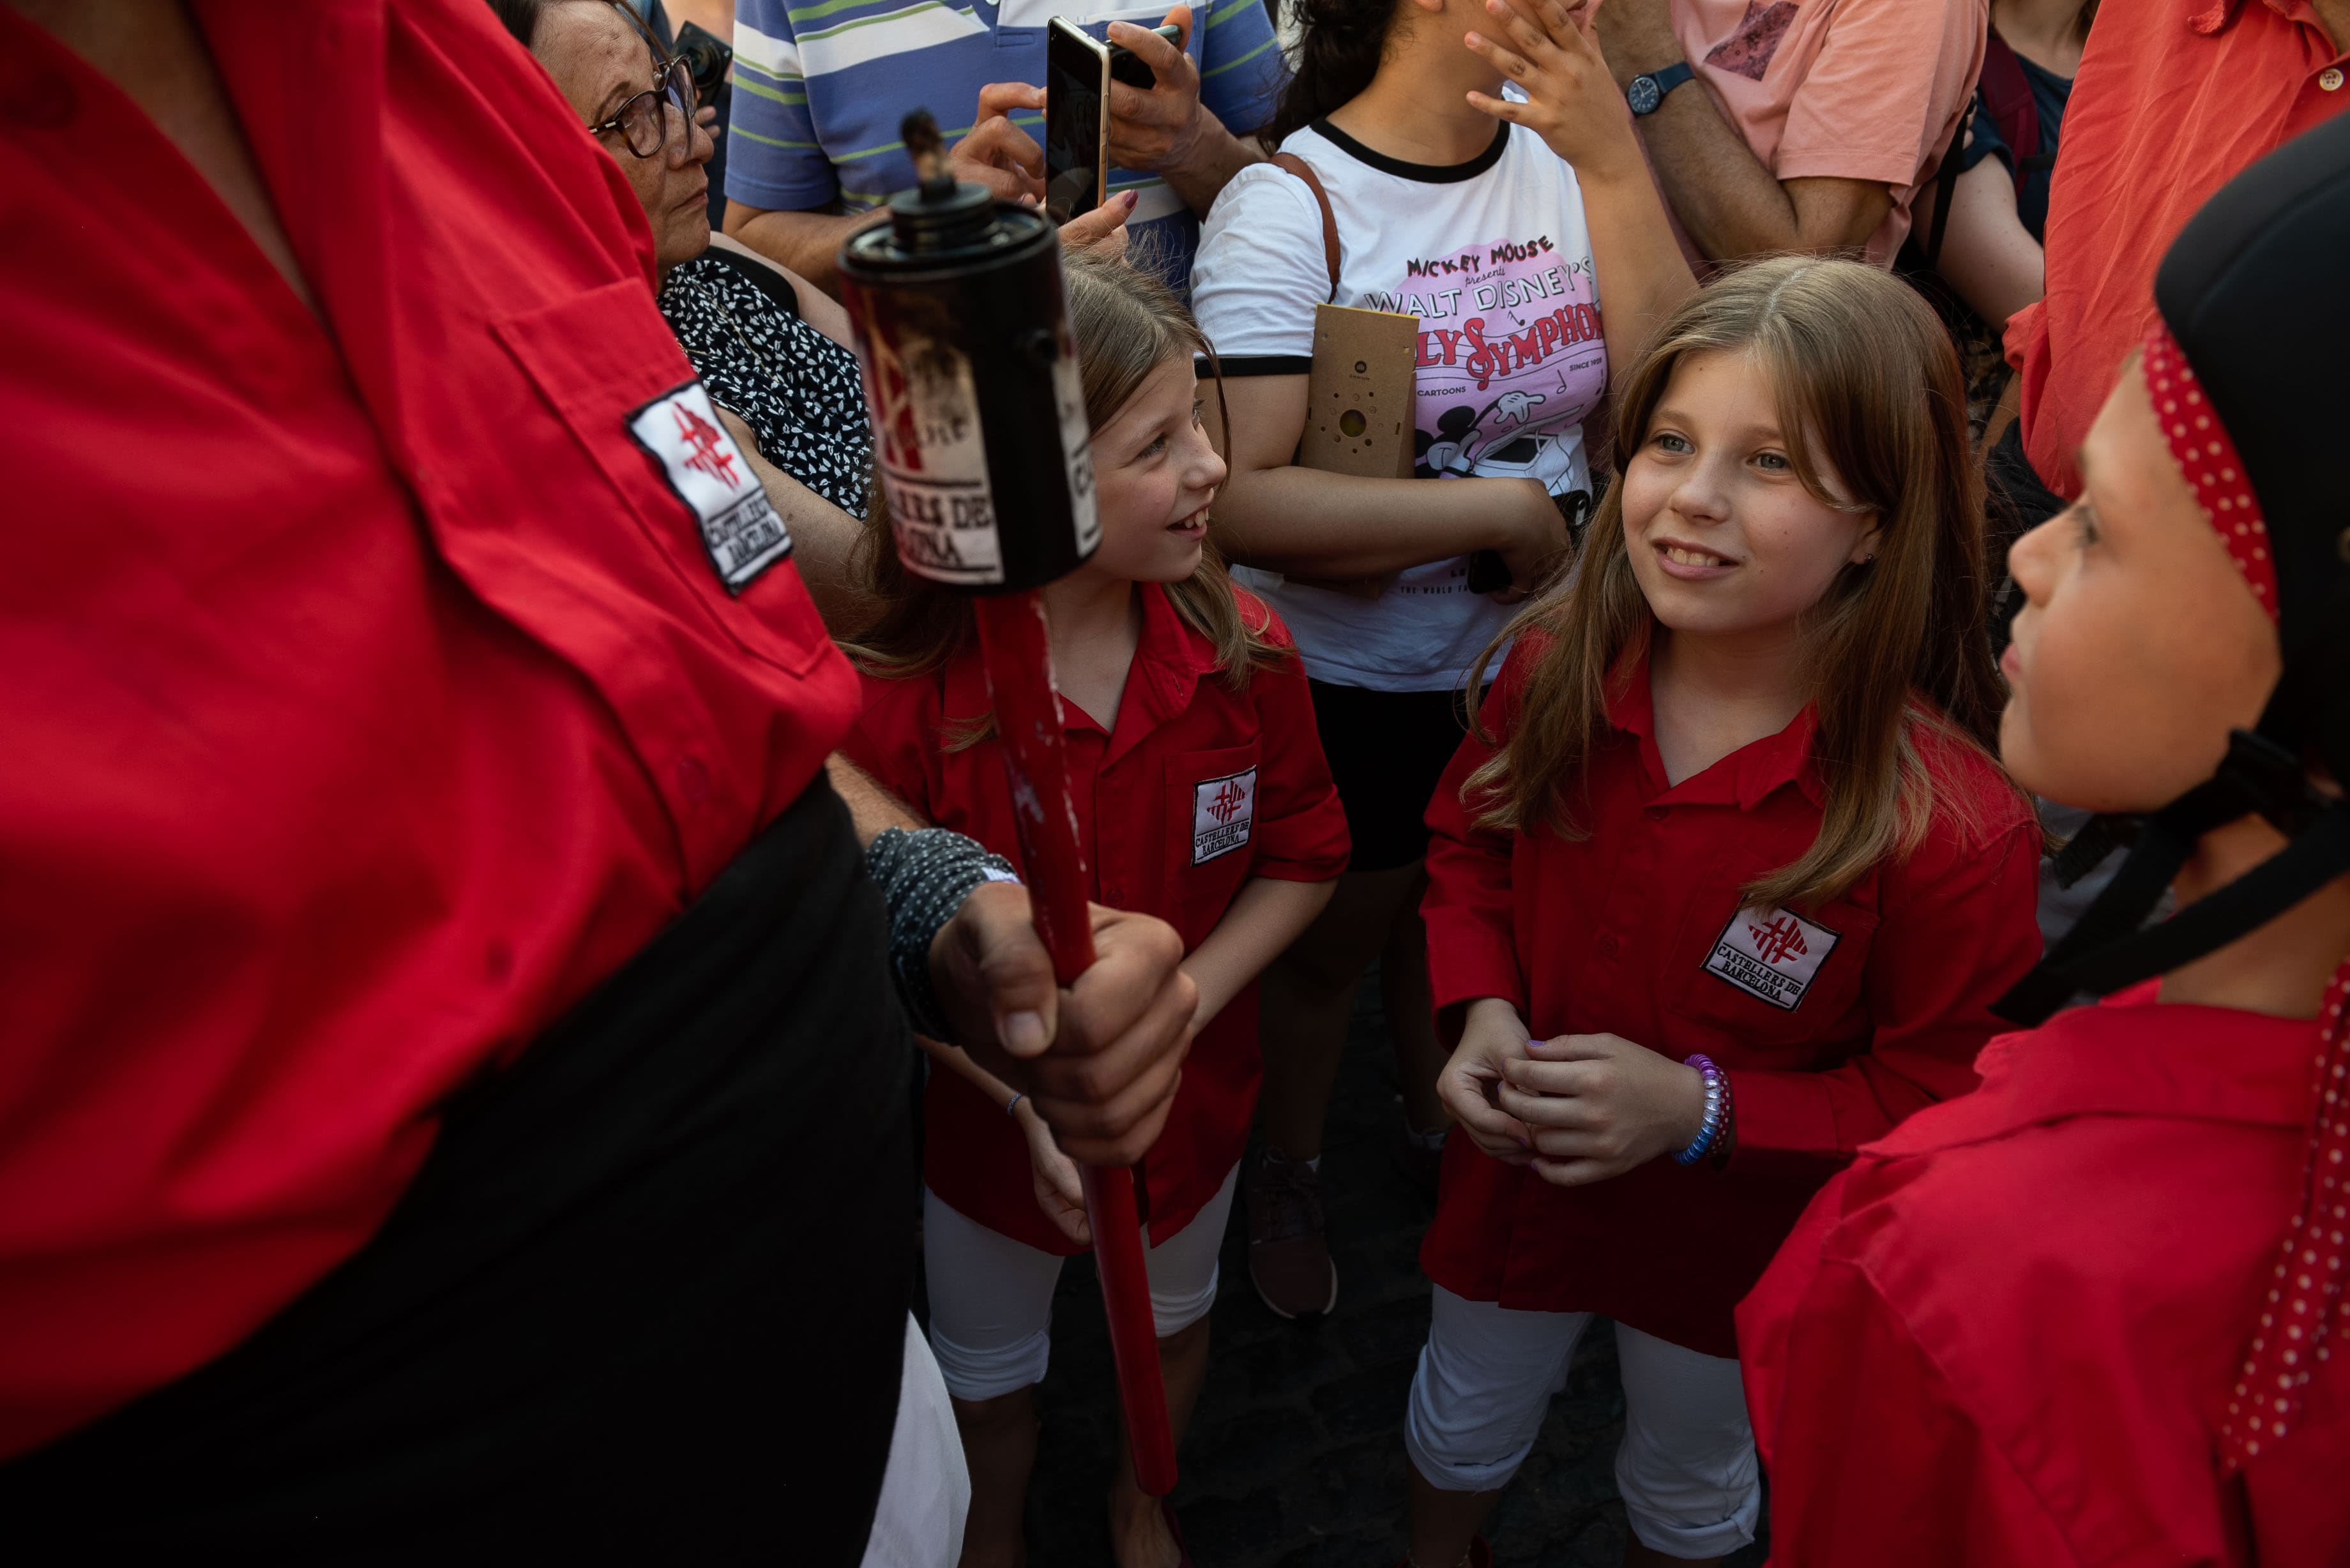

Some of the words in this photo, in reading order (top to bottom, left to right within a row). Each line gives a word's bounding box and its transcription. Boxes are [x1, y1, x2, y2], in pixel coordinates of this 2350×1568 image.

[1407, 253, 1481, 278] MICKEY
[1490, 235, 1554, 266] MOUSE
[1465, 266, 1506, 287] presents
[1364, 288, 1462, 319] WALT
[1416, 329, 1463, 366] LY
[1570, 361, 1589, 372] SINCE
[1417, 386, 1466, 396] CARTOONS
[1400, 586, 1416, 594] THE
[1423, 585, 1452, 594] WORLD
[1458, 584, 1469, 592] FA
[1195, 824, 1239, 848] CASTELLERS
[1239, 821, 1250, 833] DE
[1202, 834, 1239, 856] BARCELONA
[1717, 946, 1785, 988] CASTELLERS
[1784, 981, 1801, 995] DE
[1722, 960, 1781, 1000] BARCELONA
